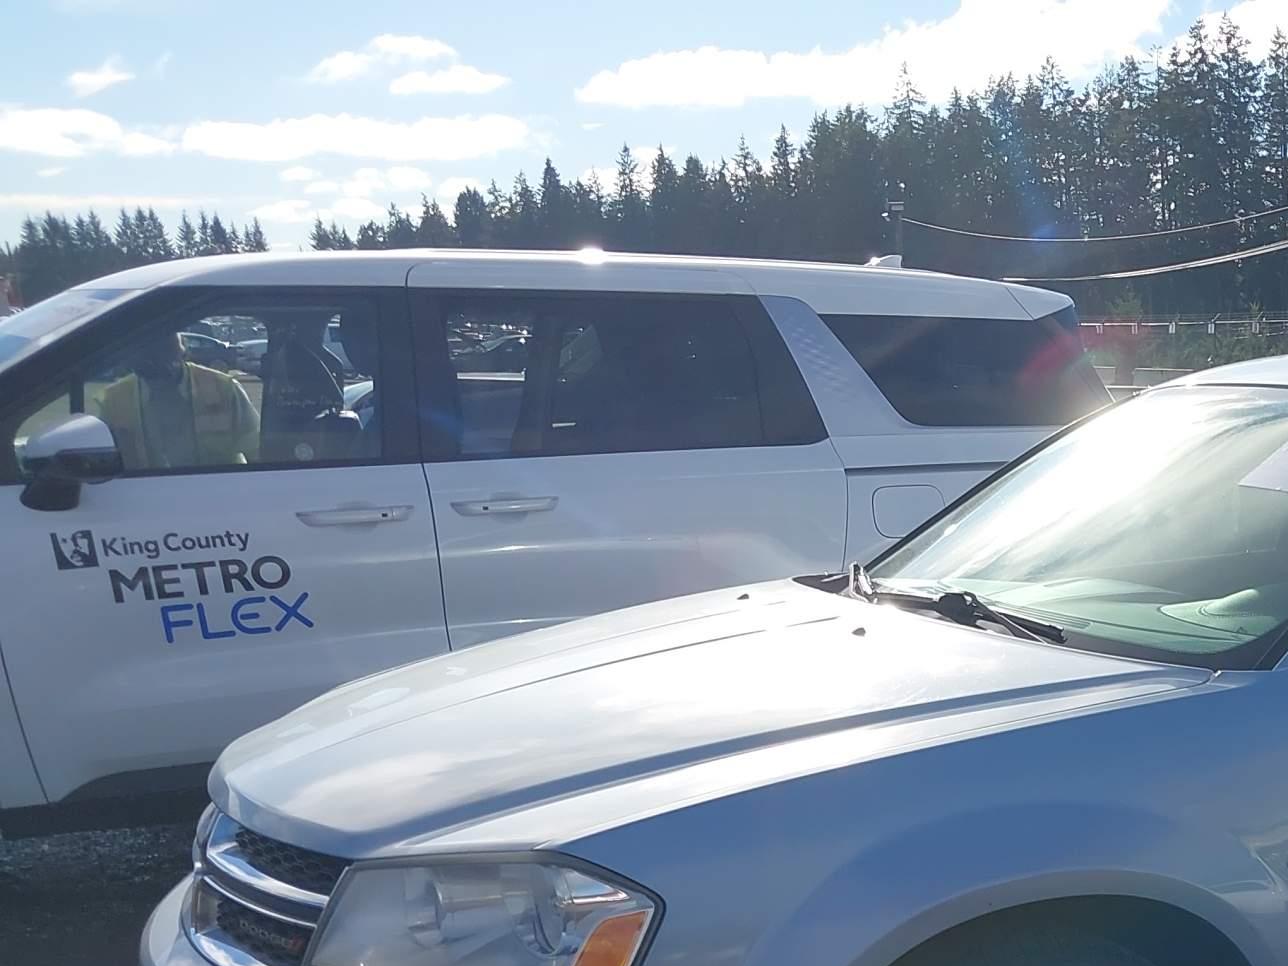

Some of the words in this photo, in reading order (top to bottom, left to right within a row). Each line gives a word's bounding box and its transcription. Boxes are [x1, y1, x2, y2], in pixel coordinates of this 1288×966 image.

[101, 536, 160, 559] King
[163, 530, 250, 552] County
[108, 555, 291, 604] METRO
[160, 592, 314, 643] FLEX
